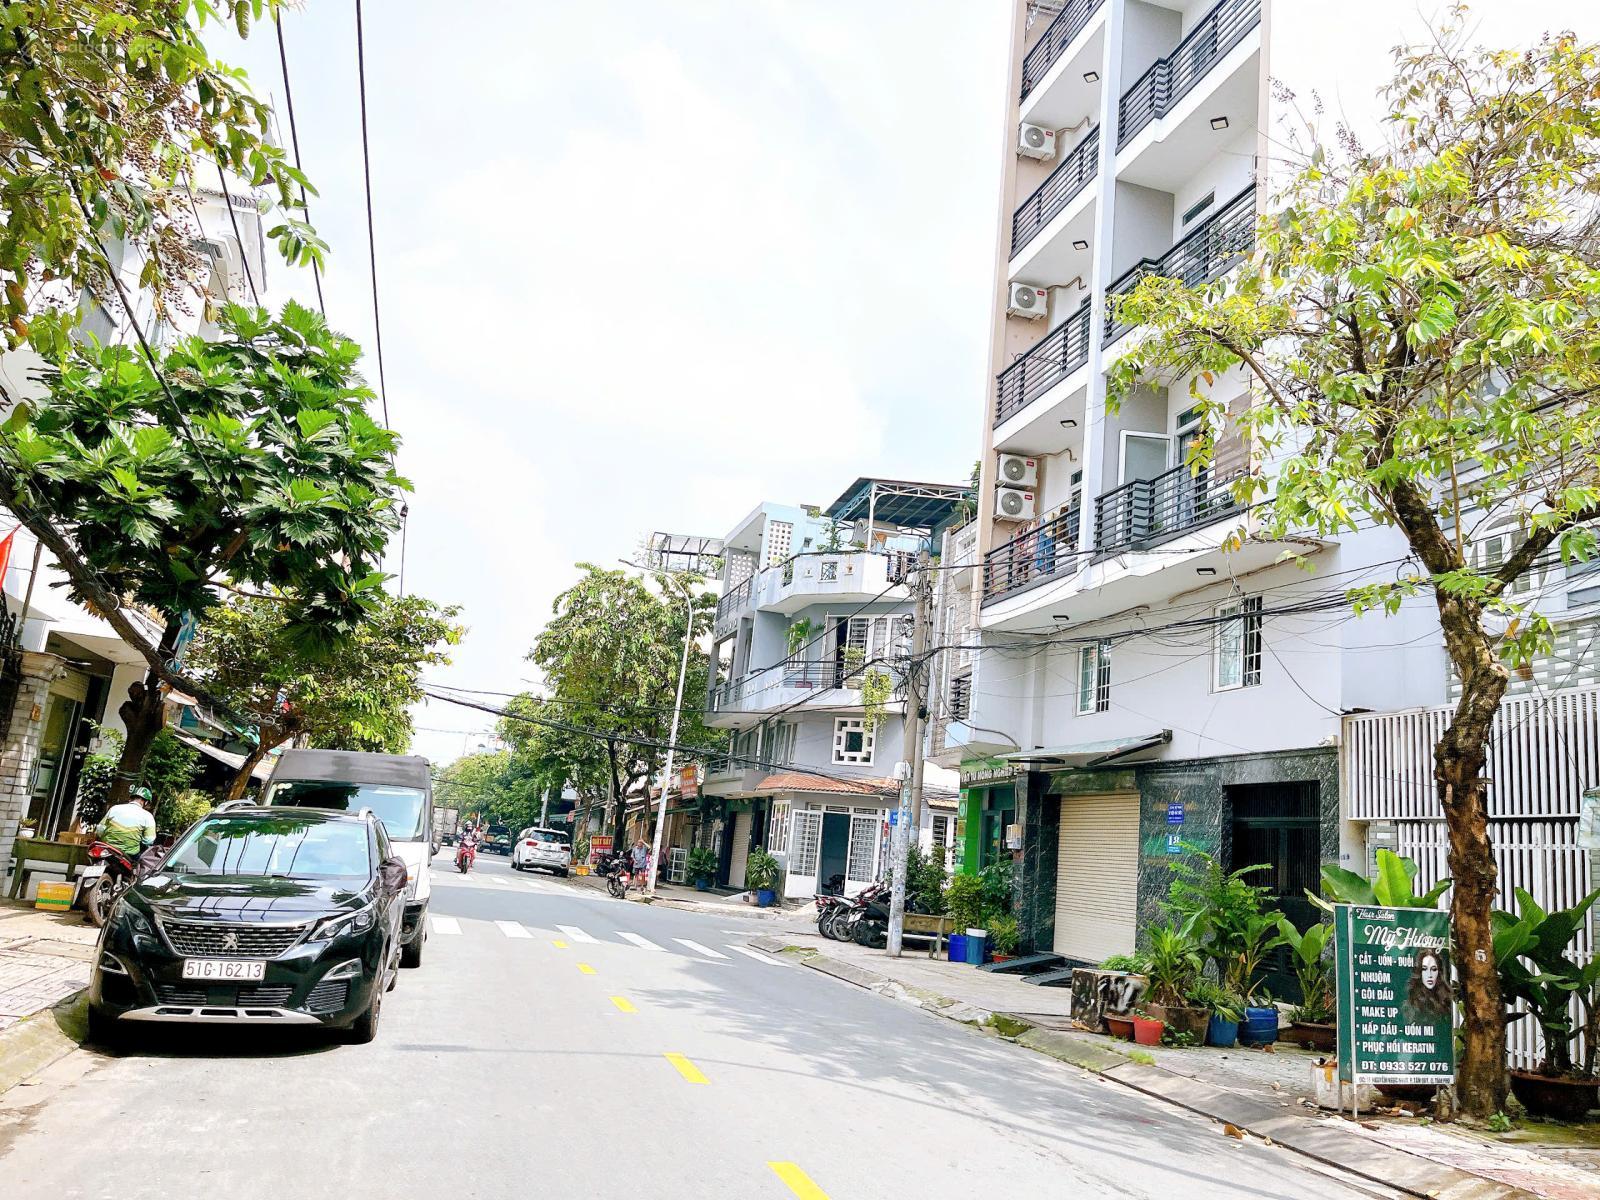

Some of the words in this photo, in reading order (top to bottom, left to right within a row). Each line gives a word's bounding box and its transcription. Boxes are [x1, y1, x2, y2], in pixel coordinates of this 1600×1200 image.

[1376, 909, 1395, 921] Salon
[1364, 924, 1396, 951] Mỹ
[1395, 926, 1446, 954] Hường
[1358, 951, 1372, 965] CẮT
[1378, 952, 1392, 966] UỐN
[186, 961, 263, 978] 51G-162.13
[1360, 970, 1391, 985] NHUỘM
[1362, 986, 1375, 1002] GỘI
[1362, 1006, 1386, 1018] MAKE
[1388, 1008, 1398, 1018] UP
[1362, 1020, 1378, 1034] HẤP
[1404, 1022, 1422, 1036] UỐN
[1424, 1026, 1434, 1036] MI
[1362, 1041, 1384, 1055] PHỤC
[1402, 1042, 1435, 1054] KERATIN
[1362, 1060, 1377, 1070] ĐT:
[1380, 1062, 1406, 1071] 0933
[1408, 1062, 1427, 1072] 527
[1430, 1062, 1449, 1072] 076
